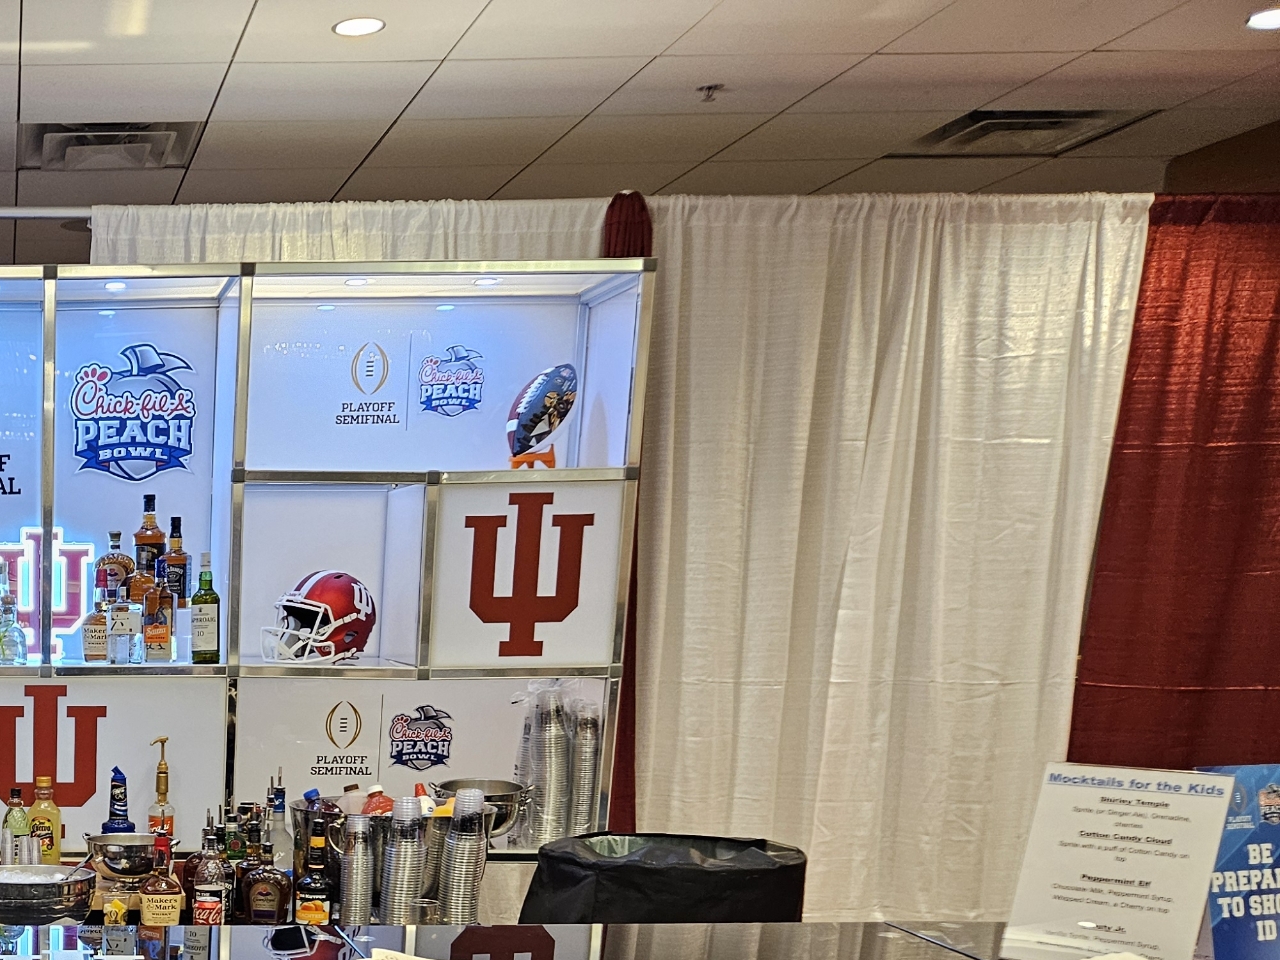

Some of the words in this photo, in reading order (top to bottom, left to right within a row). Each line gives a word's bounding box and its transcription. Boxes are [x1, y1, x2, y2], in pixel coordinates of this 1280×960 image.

[74, 378, 192, 418] Chick-fil-A
[420, 384, 482, 402] PEACH
[341, 402, 395, 412] PLAYOFF
[335, 414, 400, 425] SEMIFINAL
[75, 419, 191, 451] PEACH
[98, 447, 168, 460] BOWL
[391, 722, 451, 741] Chick-fil-A
[391, 741, 450, 756] PEACH
[402, 753, 437, 761] BOWL
[316, 755, 368, 765] PLAYOFF
[310, 766, 372, 776] SEMIFINAL
[1048, 773, 1125, 788] Mocktails
[1129, 779, 1152, 789] for
[1156, 781, 1182, 792] the
[1187, 783, 1225, 796] Kids
[1247, 843, 1274, 865] BE
[1217, 896, 1245, 918] TO
[1255, 919, 1278, 941] ID
